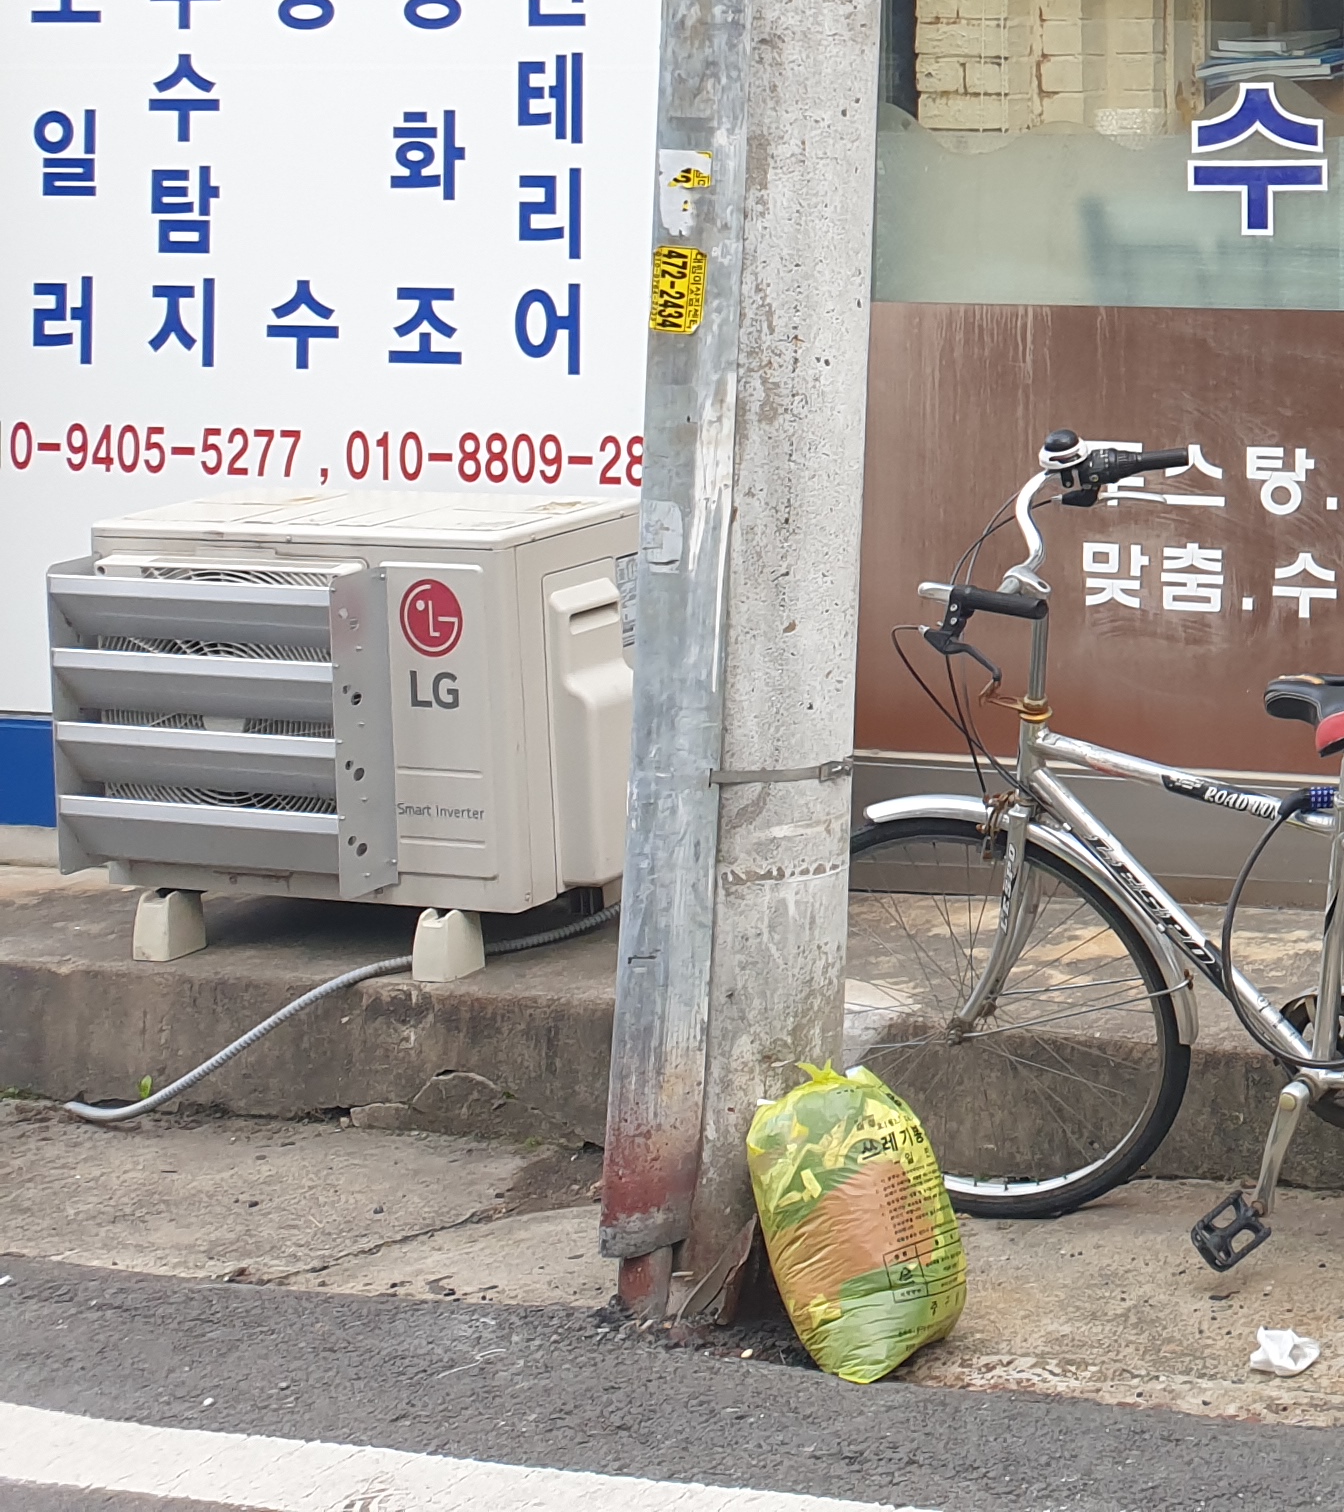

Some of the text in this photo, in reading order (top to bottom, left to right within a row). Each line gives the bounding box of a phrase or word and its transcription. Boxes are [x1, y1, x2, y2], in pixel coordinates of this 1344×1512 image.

[656, 248, 689, 330] 472-2434
[409, 670, 460, 710] LG
[397, 803, 485, 820] Smart Inverter
[1203, 786, 1250, 812] ROAD
